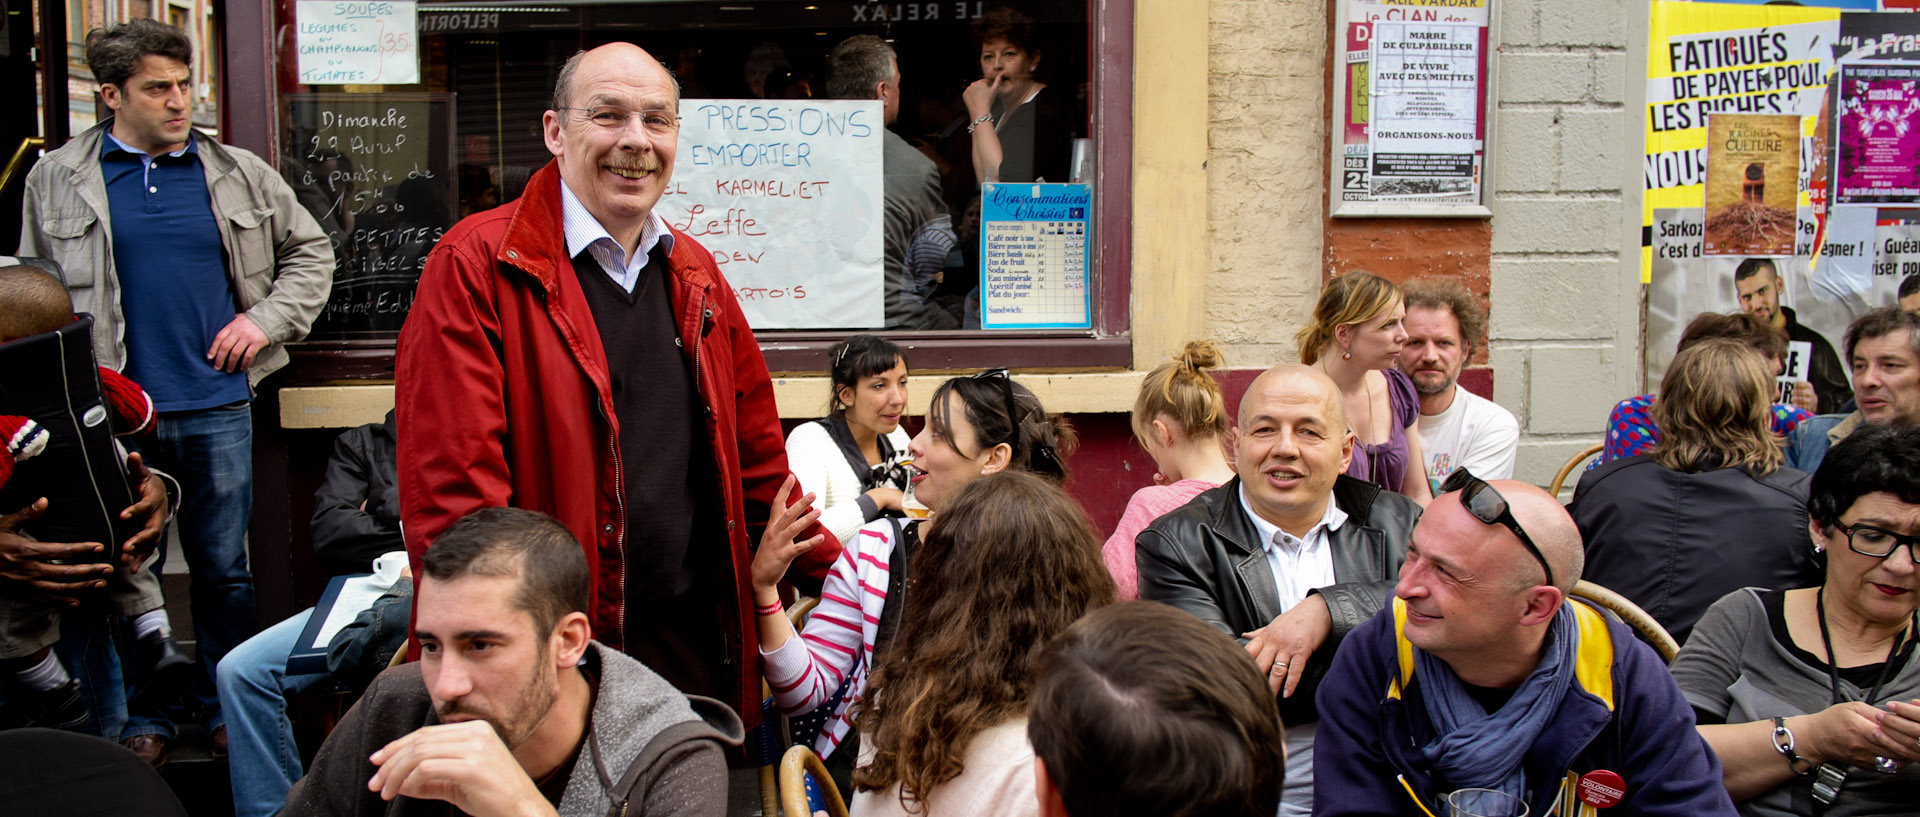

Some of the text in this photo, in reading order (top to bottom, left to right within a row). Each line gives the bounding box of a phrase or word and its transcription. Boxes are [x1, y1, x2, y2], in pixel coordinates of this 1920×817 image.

[333, 3, 393, 16] SOUPES
[1409, 32, 1447, 40] MARRE
[1880, 33, 1920, 55] Fra
[1383, 42, 1473, 51] DE CULPABILISER
[1669, 28, 1788, 73] FATIGUÉS
[1419, 63, 1449, 71] VIVRE
[1430, 73, 1474, 81] MIETTES
[1673, 74, 1700, 100] DE
[320, 108, 408, 132] Dimanche
[1650, 102, 1692, 132] LES
[1377, 131, 1475, 140] ORGANISONS-NOUS
[1725, 139, 1782, 152] CULTURE
[692, 142, 811, 168] EMPORTER
[408, 161, 435, 180] de
[993, 186, 1089, 206] Consommations
[674, 204, 767, 237] Leffe
[1014, 204, 1067, 221] Choisies
[354, 227, 443, 251] PETITES
[987, 234, 1004, 242] Café
[988, 242, 1006, 250] Bière
[1884, 237, 1920, 255] Guéa
[988, 250, 1006, 258] Bière
[1660, 243, 1690, 258] c'est
[988, 258, 999, 266] Jus
[1010, 258, 1025, 266] fruit
[988, 283, 1015, 291] Apéritif
[1582, 779, 1623, 798] VOLONTAIRE
